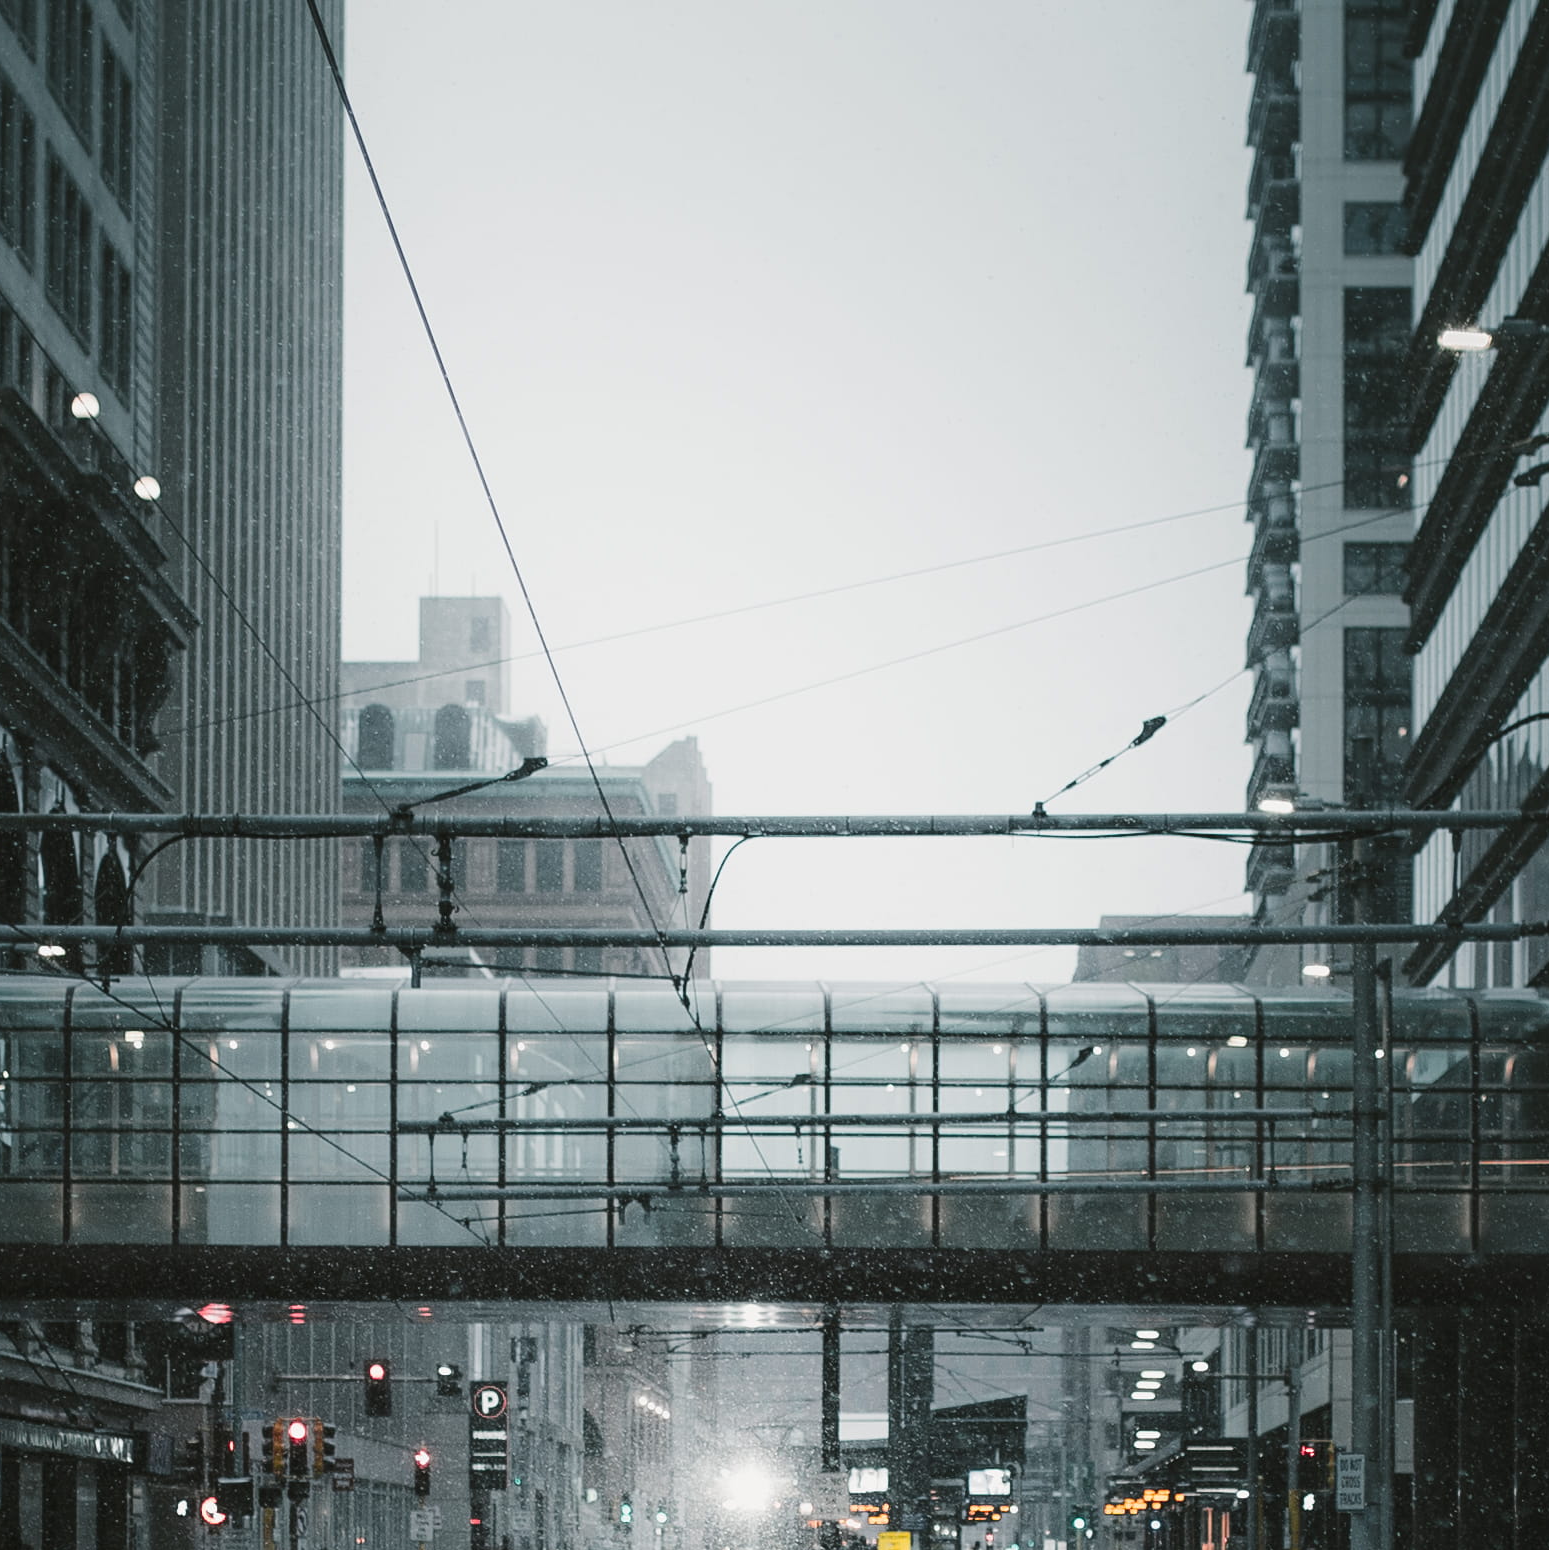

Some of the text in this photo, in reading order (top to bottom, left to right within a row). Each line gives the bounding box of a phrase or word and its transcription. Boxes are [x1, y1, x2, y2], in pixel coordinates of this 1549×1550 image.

[481, 1390, 499, 1414] P
[1340, 1458, 1362, 1472] DO NOT
[1341, 1475, 1361, 1488] CROSS
[1340, 1492, 1362, 1505] TRACKS
